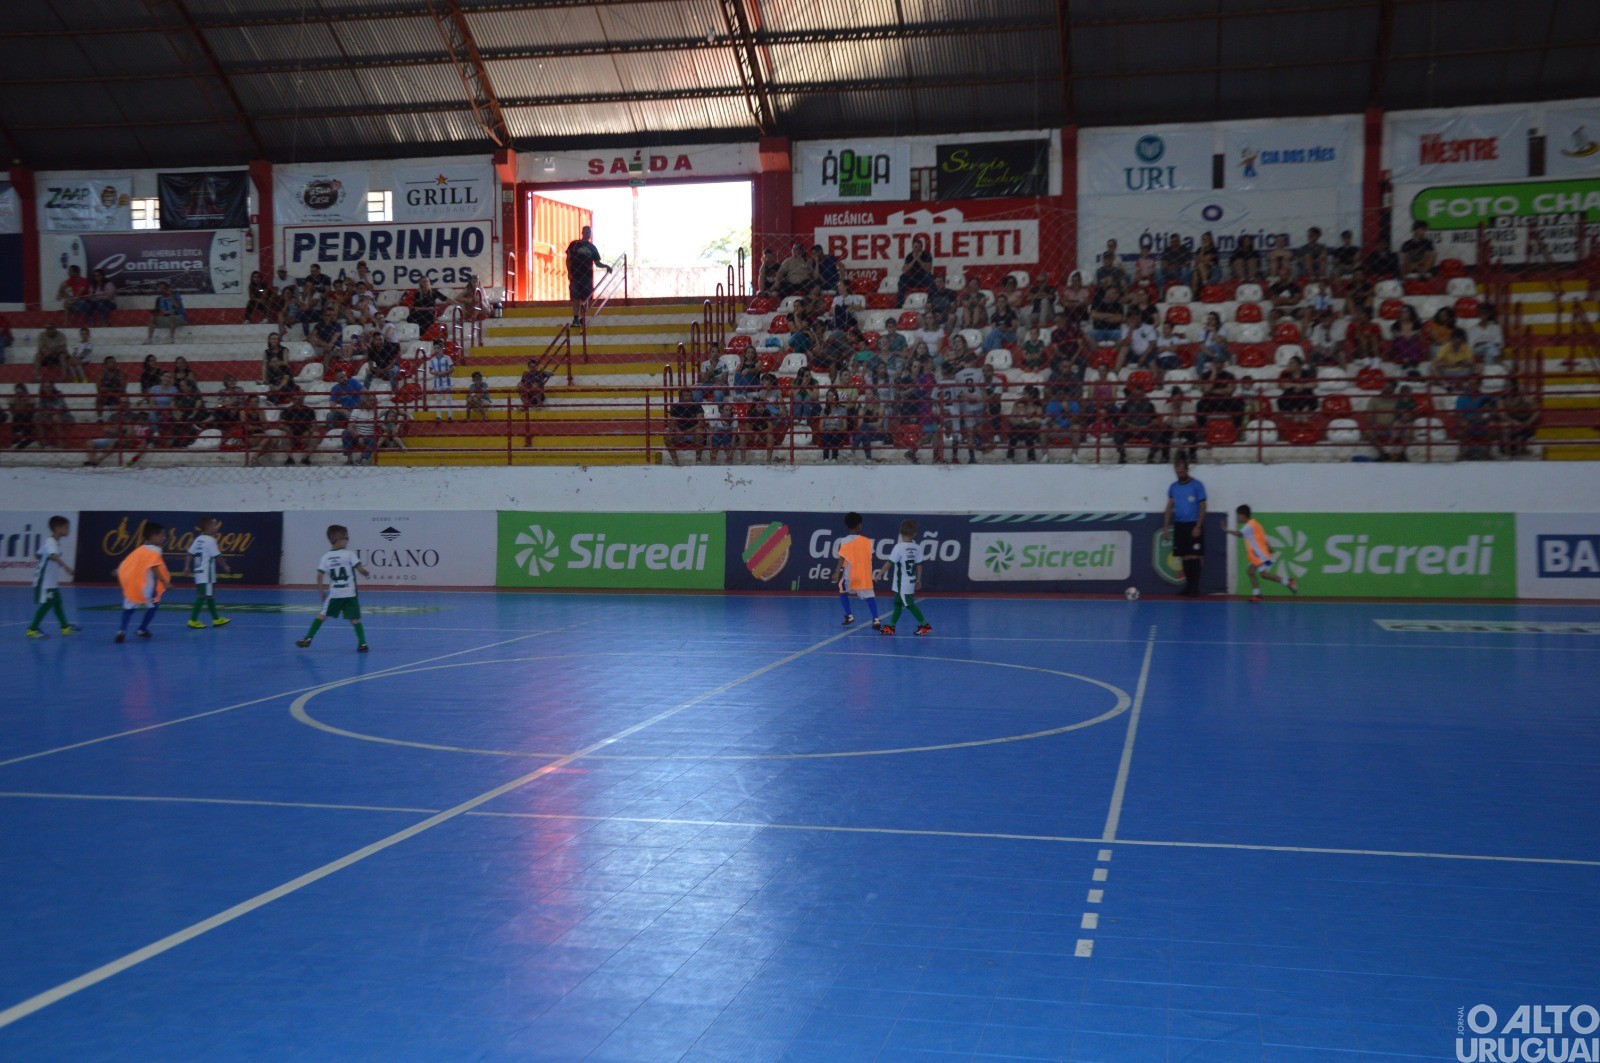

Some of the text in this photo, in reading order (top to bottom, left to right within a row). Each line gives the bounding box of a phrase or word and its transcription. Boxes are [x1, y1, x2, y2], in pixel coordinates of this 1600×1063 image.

[1123, 166, 1178, 191] URI
[407, 187, 478, 206] GRILL
[1427, 196, 1519, 218] FOTO
[824, 211, 874, 226] MECÂNICA
[293, 226, 484, 263] PEDRINHO
[1139, 228, 1194, 251] Ótia
[95, 253, 203, 278] Confiança
[339, 267, 386, 286] Ao
[567, 533, 709, 570] Sicredi
[809, 529, 961, 561] Gcão
[1020, 544, 1116, 568] Sicredi
[1322, 534, 1495, 575] Sicredi
[356, 549, 440, 567] UGANO
[809, 563, 830, 580] de
